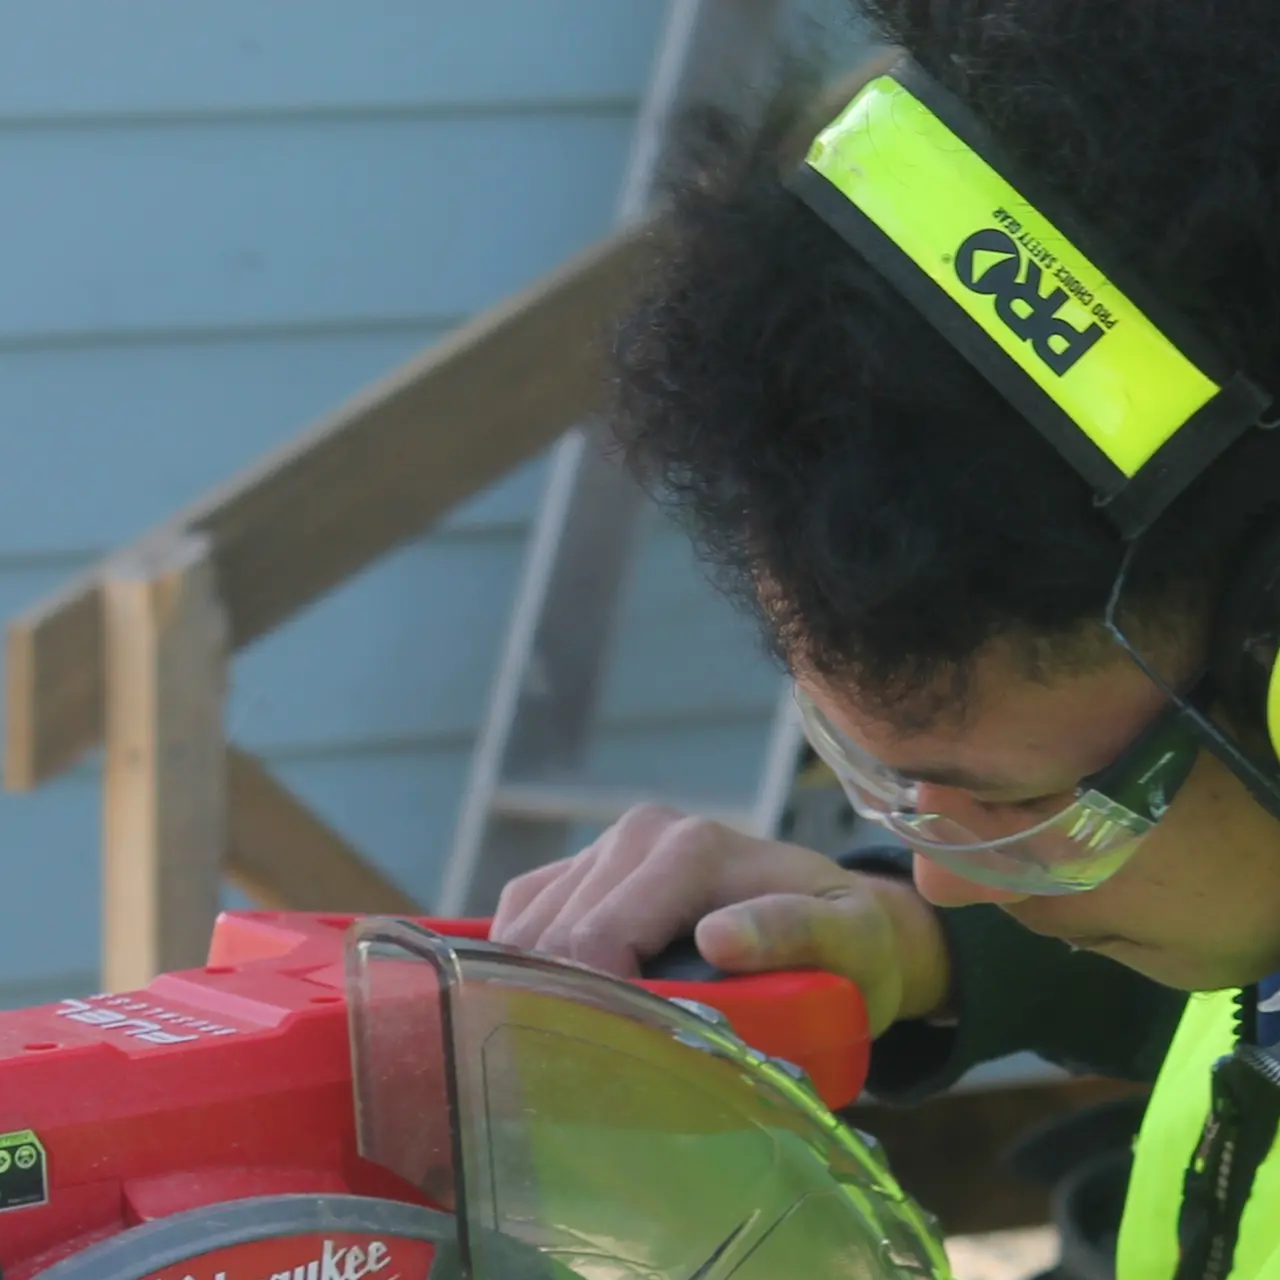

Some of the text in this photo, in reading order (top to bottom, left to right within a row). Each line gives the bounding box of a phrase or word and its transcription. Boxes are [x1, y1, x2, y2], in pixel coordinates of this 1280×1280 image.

[992, 207, 1118, 329] PRO CHOICE SAFETY GEAR
